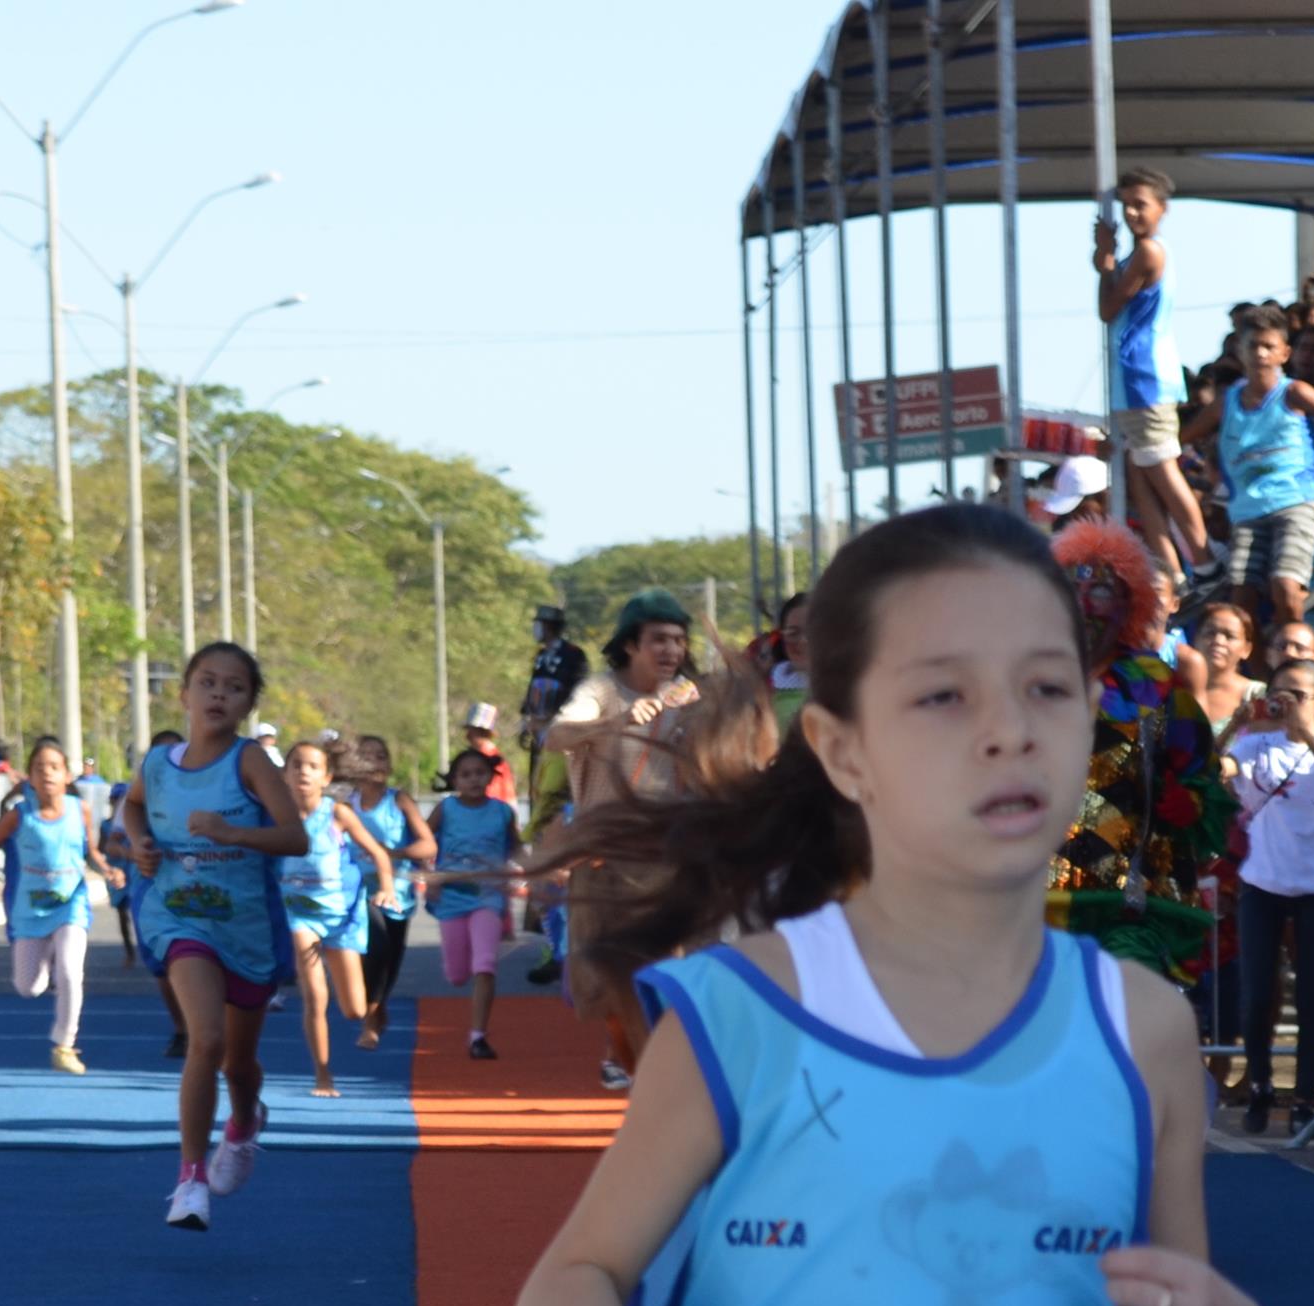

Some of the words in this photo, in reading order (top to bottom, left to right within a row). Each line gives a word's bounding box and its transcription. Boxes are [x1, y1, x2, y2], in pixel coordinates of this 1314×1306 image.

[897, 404, 988, 430] Aeroorto
[725, 1219, 806, 1248] CAIXA
[1033, 1226, 1124, 1255] CAIXA
